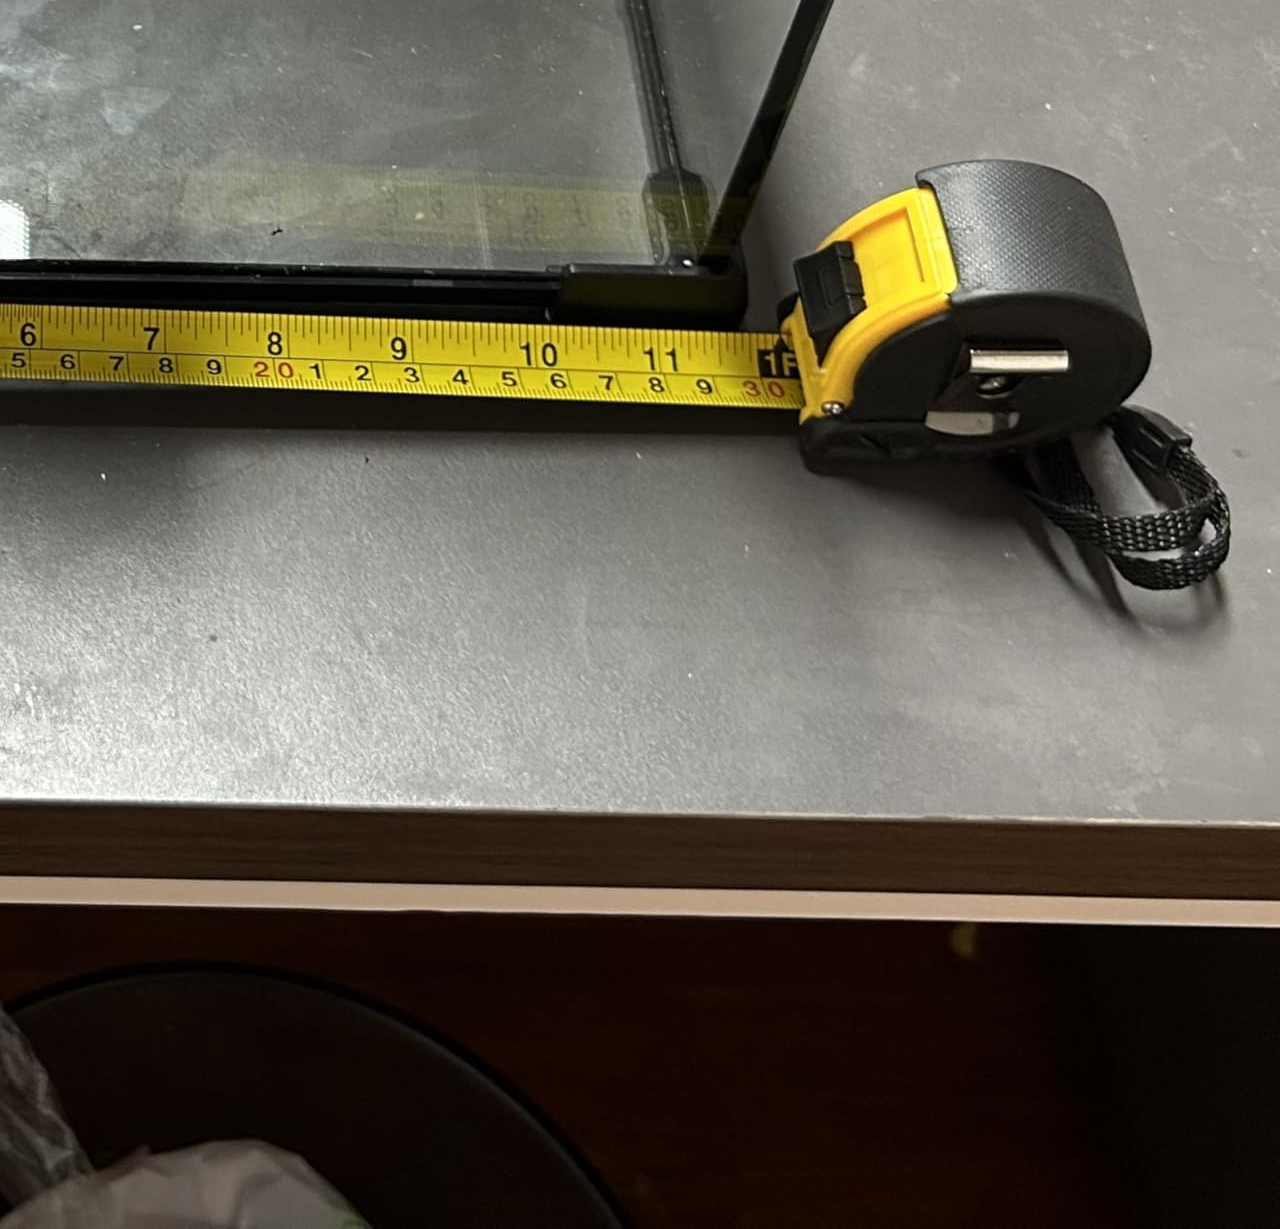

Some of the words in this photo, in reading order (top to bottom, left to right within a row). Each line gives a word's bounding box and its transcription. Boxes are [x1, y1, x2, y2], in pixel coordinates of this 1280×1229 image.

[20, 322, 37, 347] 6
[143, 327, 160, 351] 7
[267, 331, 283, 356] 8
[390, 337, 408, 361] 9
[520, 341, 558, 367] 10
[643, 346, 679, 373] 11
[11, 352, 26, 368] 5
[60, 354, 76, 370] 6
[109, 356, 124, 371] 7
[158, 357, 173, 374] 8
[206, 359, 222, 375] 9
[253, 361, 294, 379] 20
[309, 363, 322, 380] 1
[354, 365, 372, 381] 2
[403, 367, 420, 383] 3
[452, 369, 469, 386] 4
[501, 371, 518, 387] 5
[550, 373, 567, 389] 6
[598, 375, 614, 391] 7
[648, 377, 665, 393] 8
[696, 379, 713, 395] 9
[742, 380, 785, 399] 30
